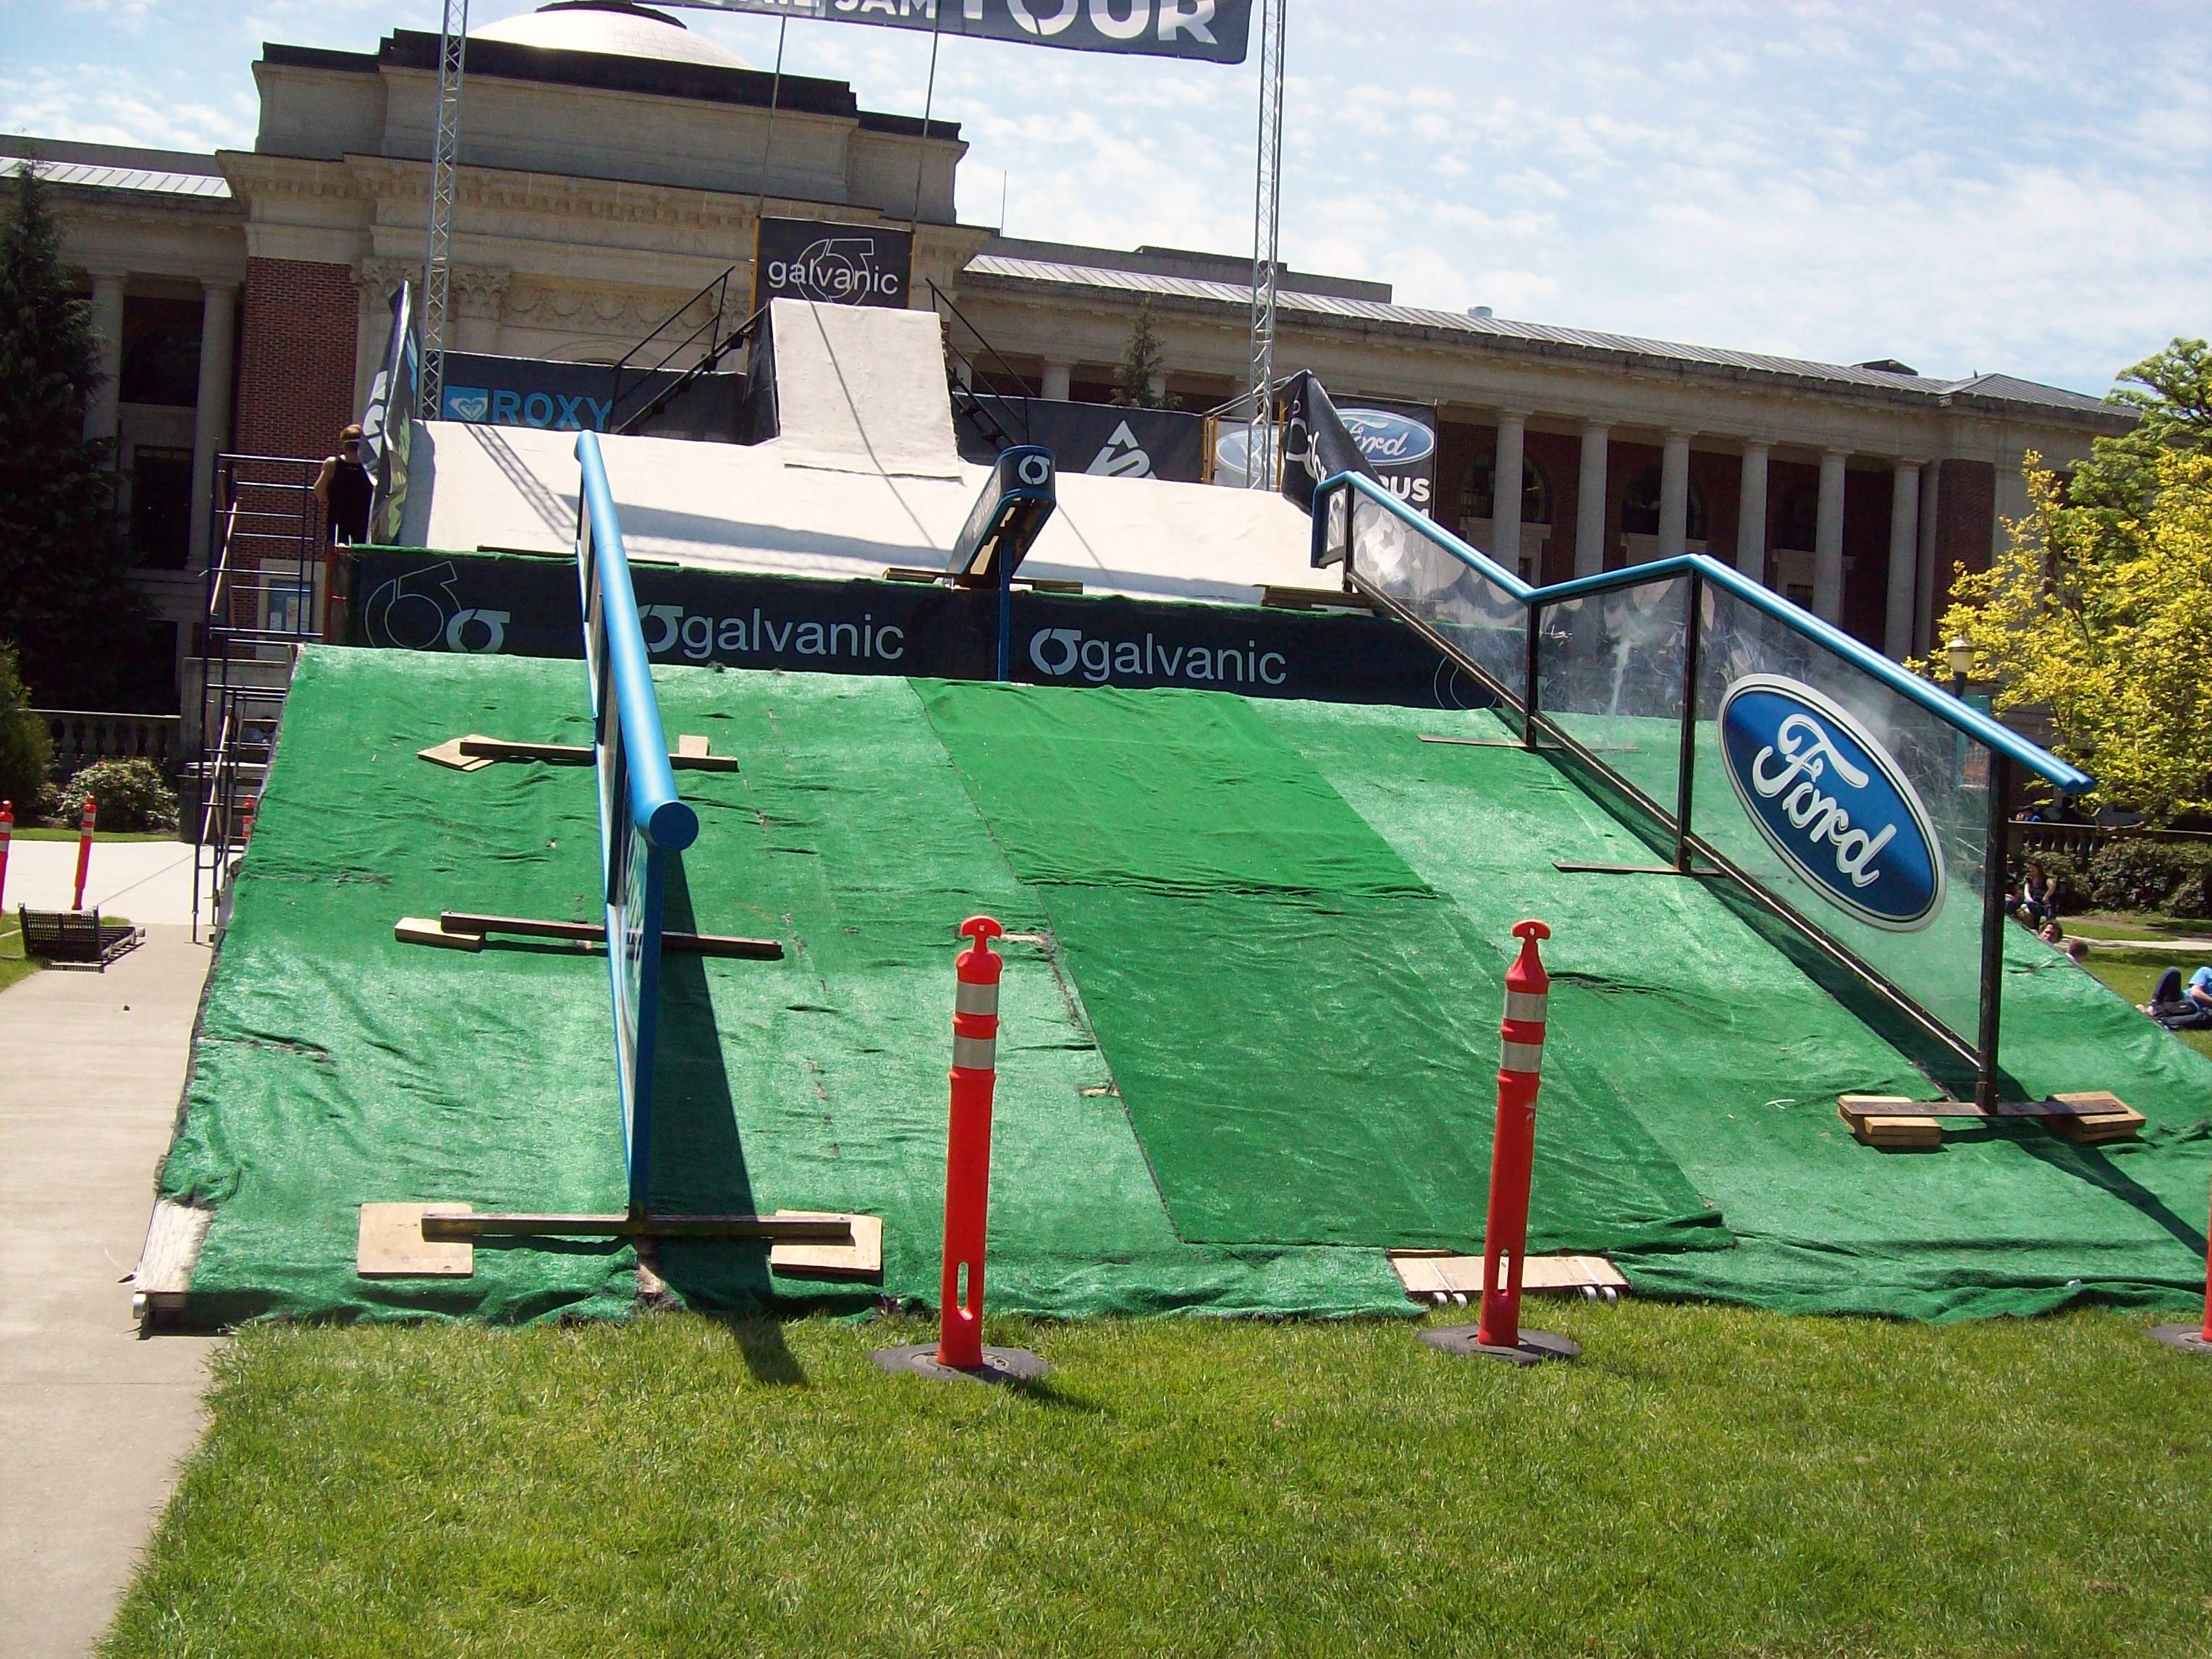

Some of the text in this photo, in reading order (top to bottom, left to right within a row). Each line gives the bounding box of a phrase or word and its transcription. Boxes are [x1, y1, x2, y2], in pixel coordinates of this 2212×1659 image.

[768, 258, 899, 295] galvanic
[491, 389, 614, 432] ROXY
[681, 607, 905, 659] galvanic
[1080, 633, 1286, 684] galvanic
[1752, 714, 1896, 888] Ford
